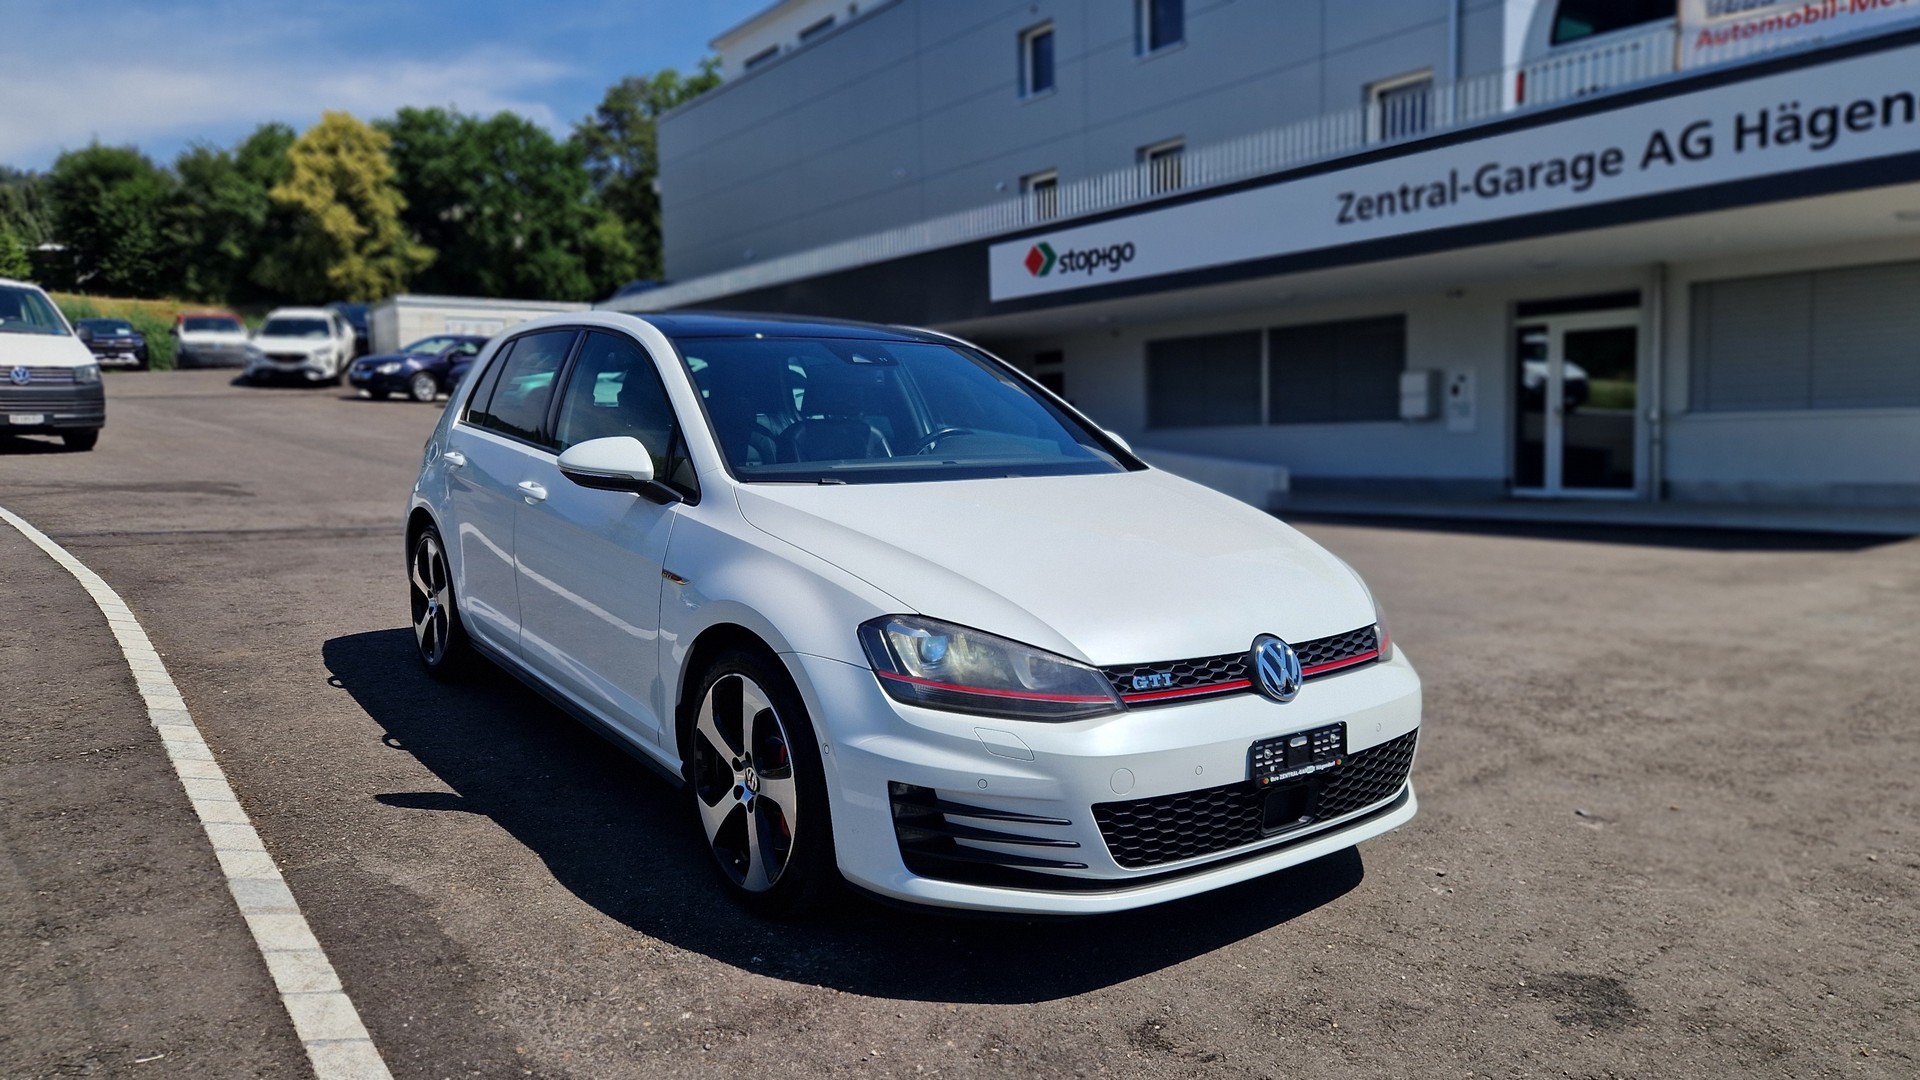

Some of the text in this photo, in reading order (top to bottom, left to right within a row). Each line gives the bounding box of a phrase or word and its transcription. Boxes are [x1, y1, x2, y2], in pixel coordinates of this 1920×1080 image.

[1695, 0, 1908, 49] Automobil-M
[1336, 91, 1920, 226] Zentral-Garage AG Hägen
[1058, 241, 1136, 277] stop+go
[1132, 672, 1174, 692] GTI
